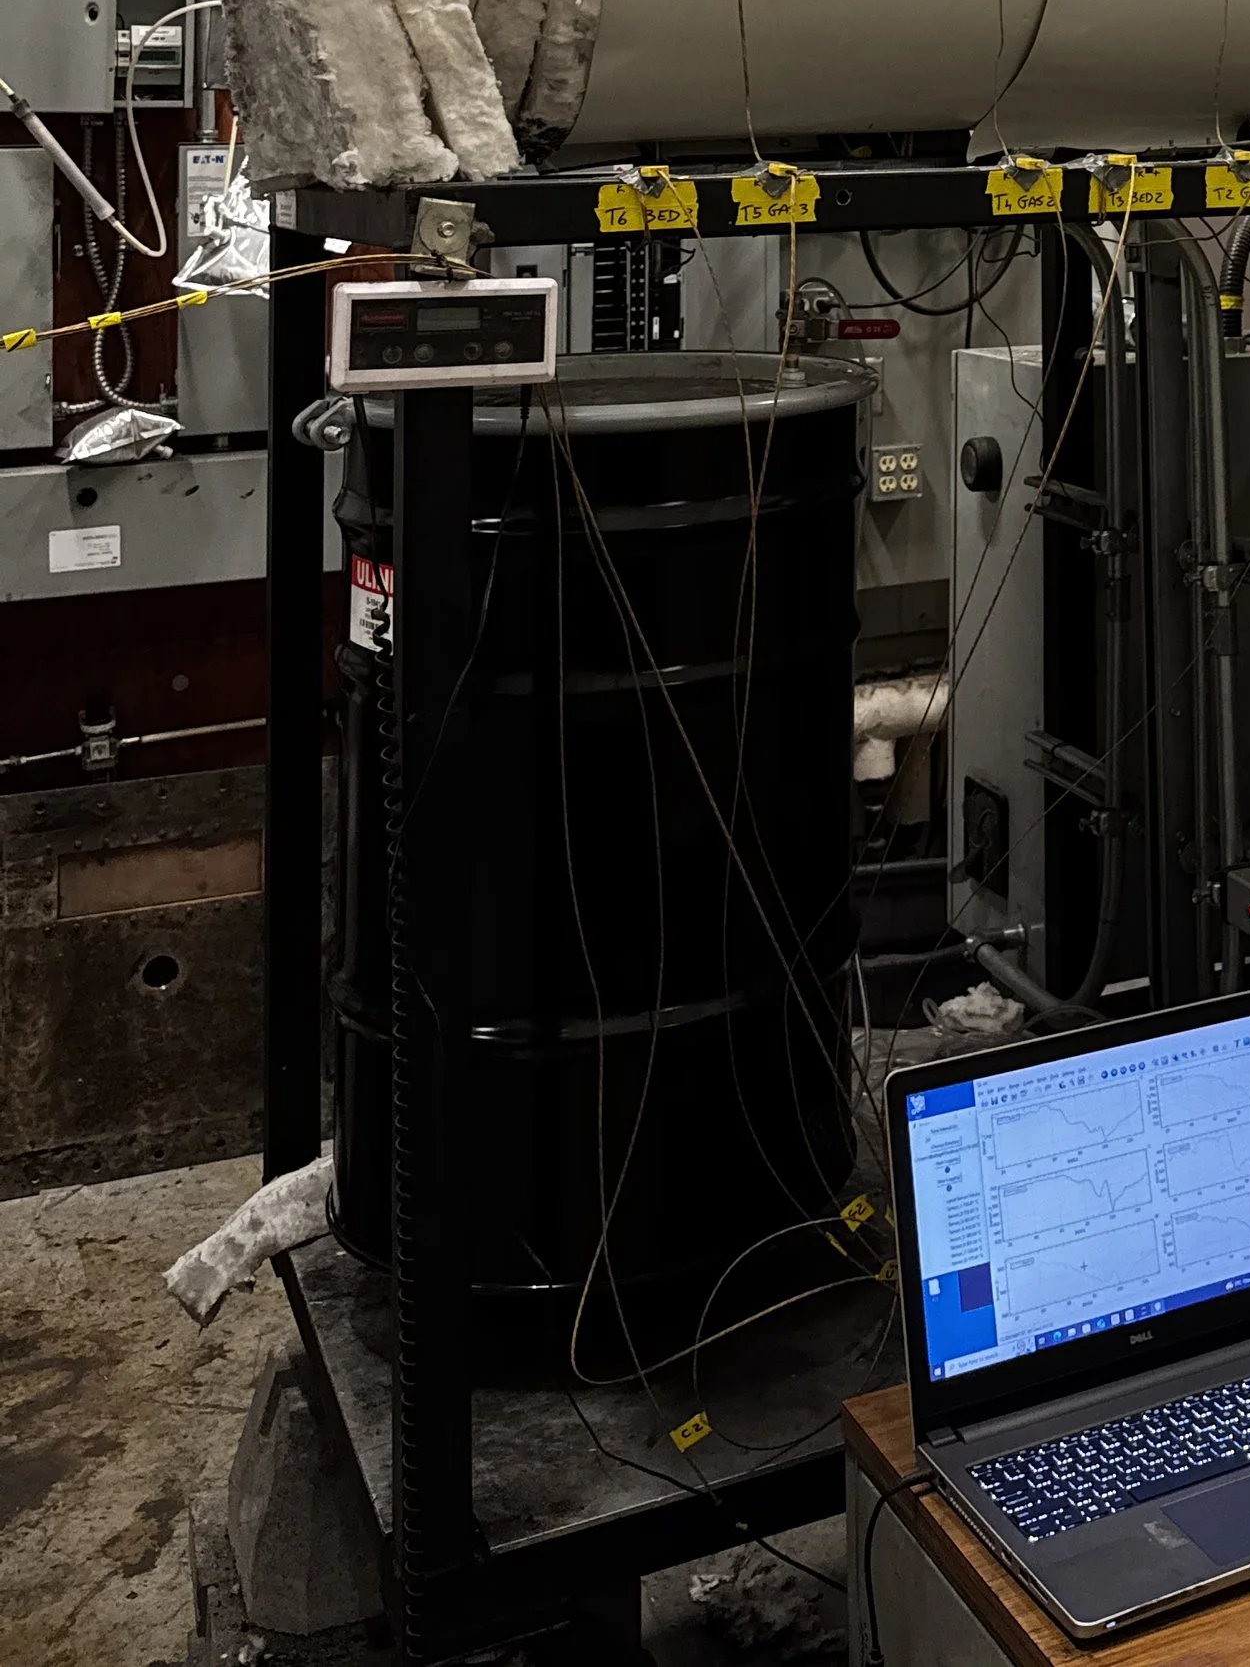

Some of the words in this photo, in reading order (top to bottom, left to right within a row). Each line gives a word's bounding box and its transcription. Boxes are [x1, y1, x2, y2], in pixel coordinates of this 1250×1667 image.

[994, 194, 1012, 208] T4
[1108, 192, 1125, 208] T3
[1213, 188, 1233, 201] T2
[605, 207, 628, 226] T6
[741, 204, 763, 219] T5
